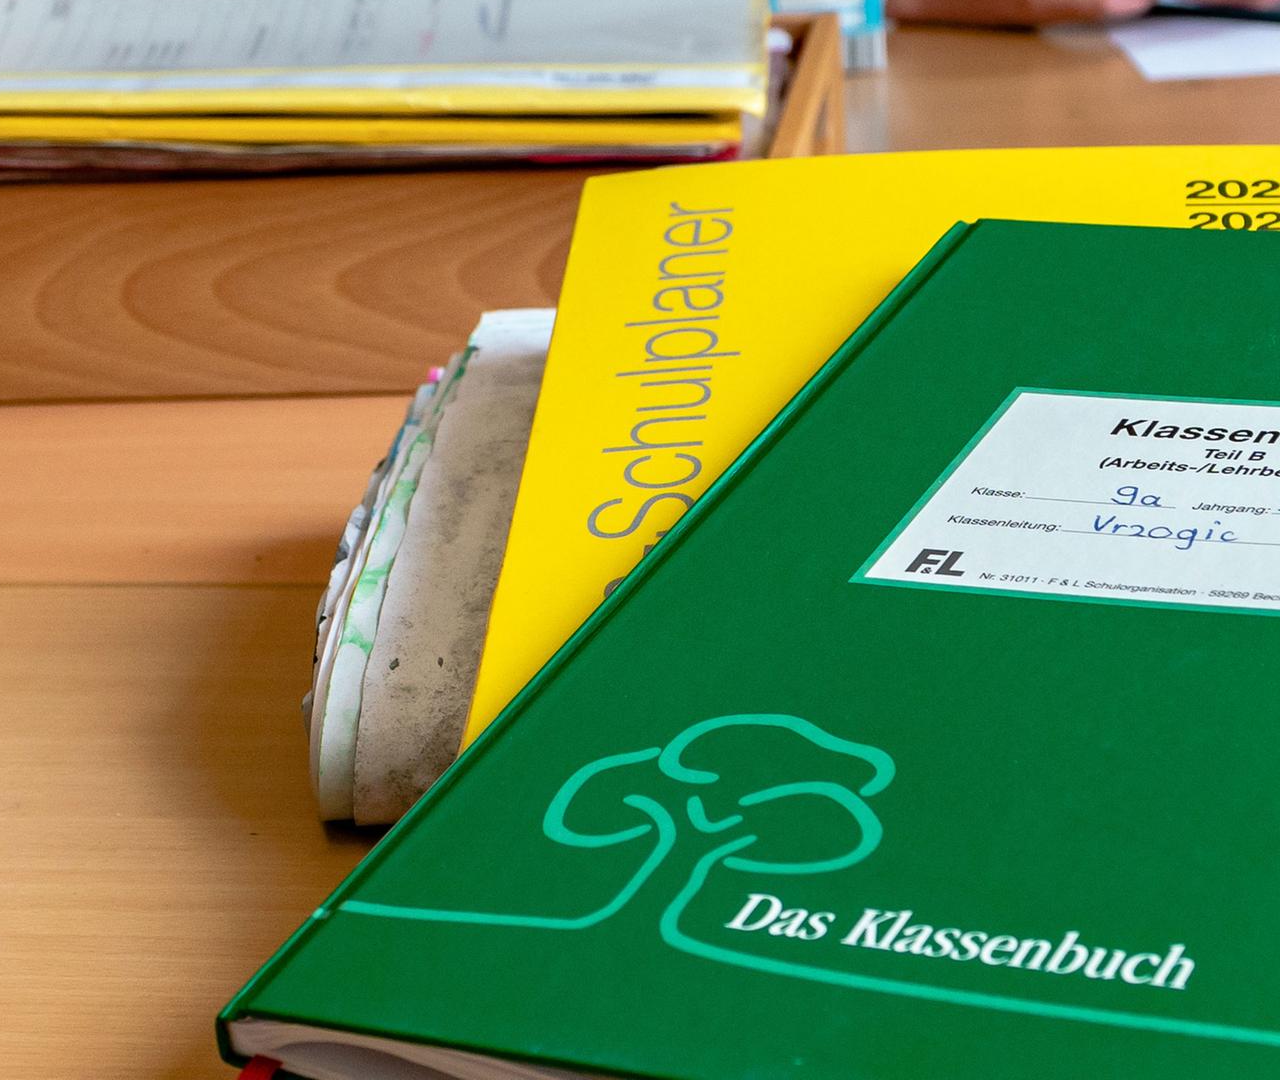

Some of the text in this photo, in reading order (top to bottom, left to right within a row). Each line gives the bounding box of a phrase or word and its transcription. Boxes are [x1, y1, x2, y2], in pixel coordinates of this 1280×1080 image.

[587, 202, 741, 539] Schulplaner
[1203, 448, 1267, 462] Teil B
[971, 486, 1026, 499] Klasse:
[1111, 485, 1162, 507] 9a
[1192, 502, 1271, 516] Jahrgang:
[947, 514, 1062, 532] Klassenleitung:
[978, 572, 996, 581] Nr.
[999, 574, 1038, 584] 31011
[1048, 578, 1058, 586] F
[1083, 580, 1197, 597] Schulorganisation
[723, 893, 1196, 990] Das Klassenbuch
